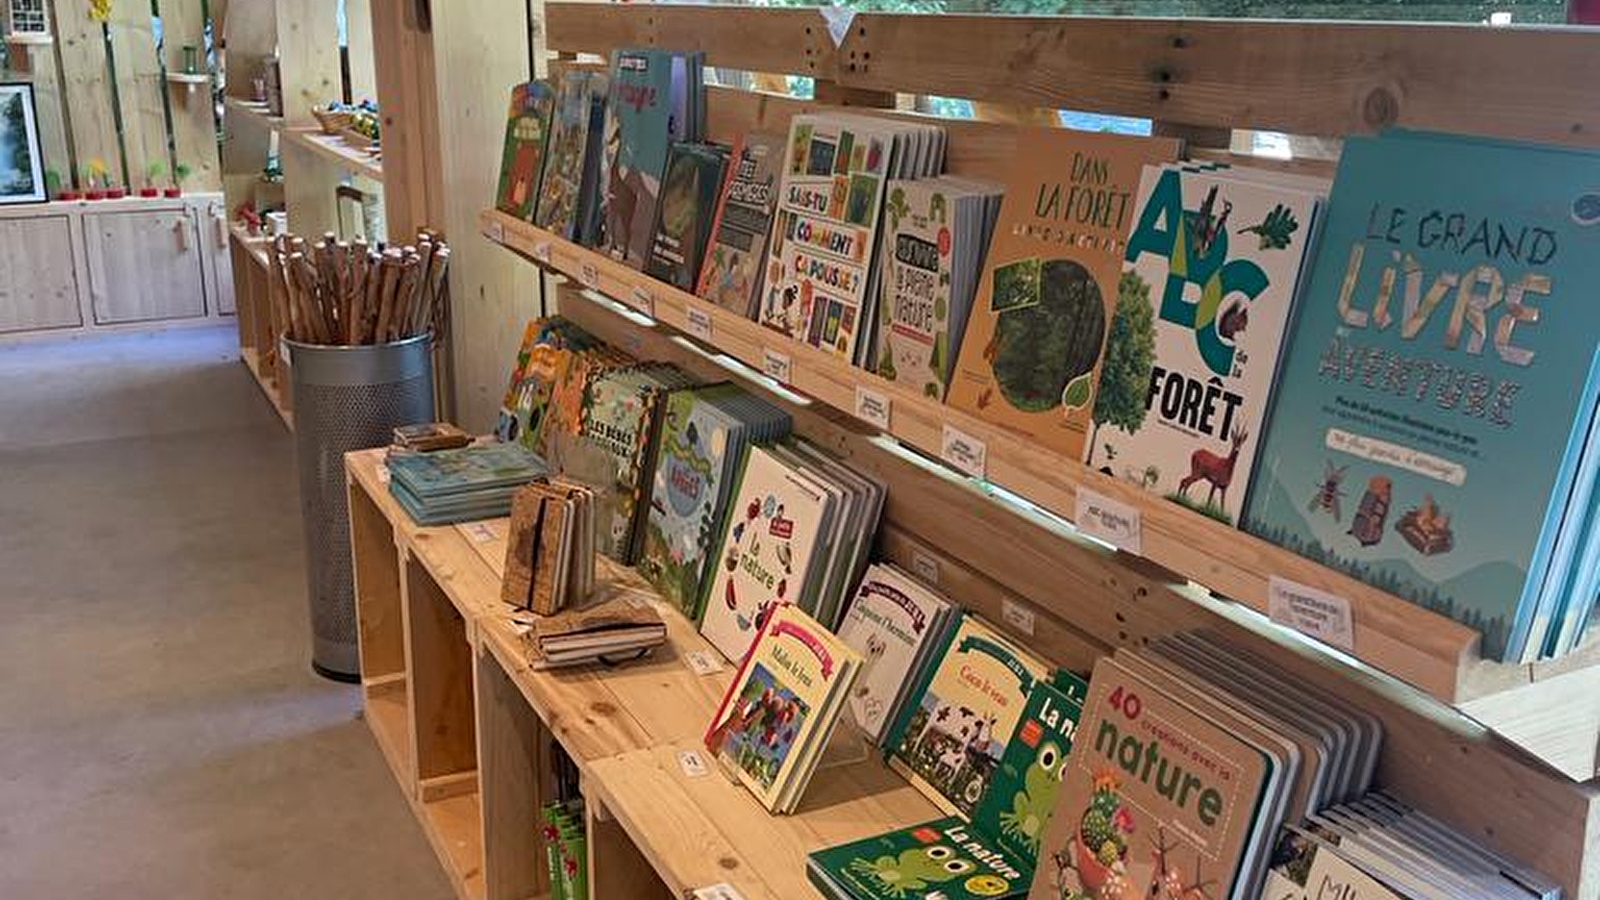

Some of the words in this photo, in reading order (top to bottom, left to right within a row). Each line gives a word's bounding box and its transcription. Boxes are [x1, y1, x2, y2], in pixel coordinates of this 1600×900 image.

[1070, 151, 1109, 184] DANS
[1035, 182, 1061, 219] LA
[1064, 185, 1131, 231] FORÊT
[797, 217, 854, 256] COMMENT
[1366, 200, 1407, 245] LE
[1416, 208, 1559, 267] GRAND
[1125, 168, 1269, 377] ABC
[1146, 366, 1244, 443] FORÊT
[740, 552, 776, 592] nature
[1038, 697, 1060, 729] La
[1108, 685, 1141, 720] 40
[1095, 718, 1223, 827] nature
[943, 826, 970, 844] La
[961, 840, 1022, 880] nature
